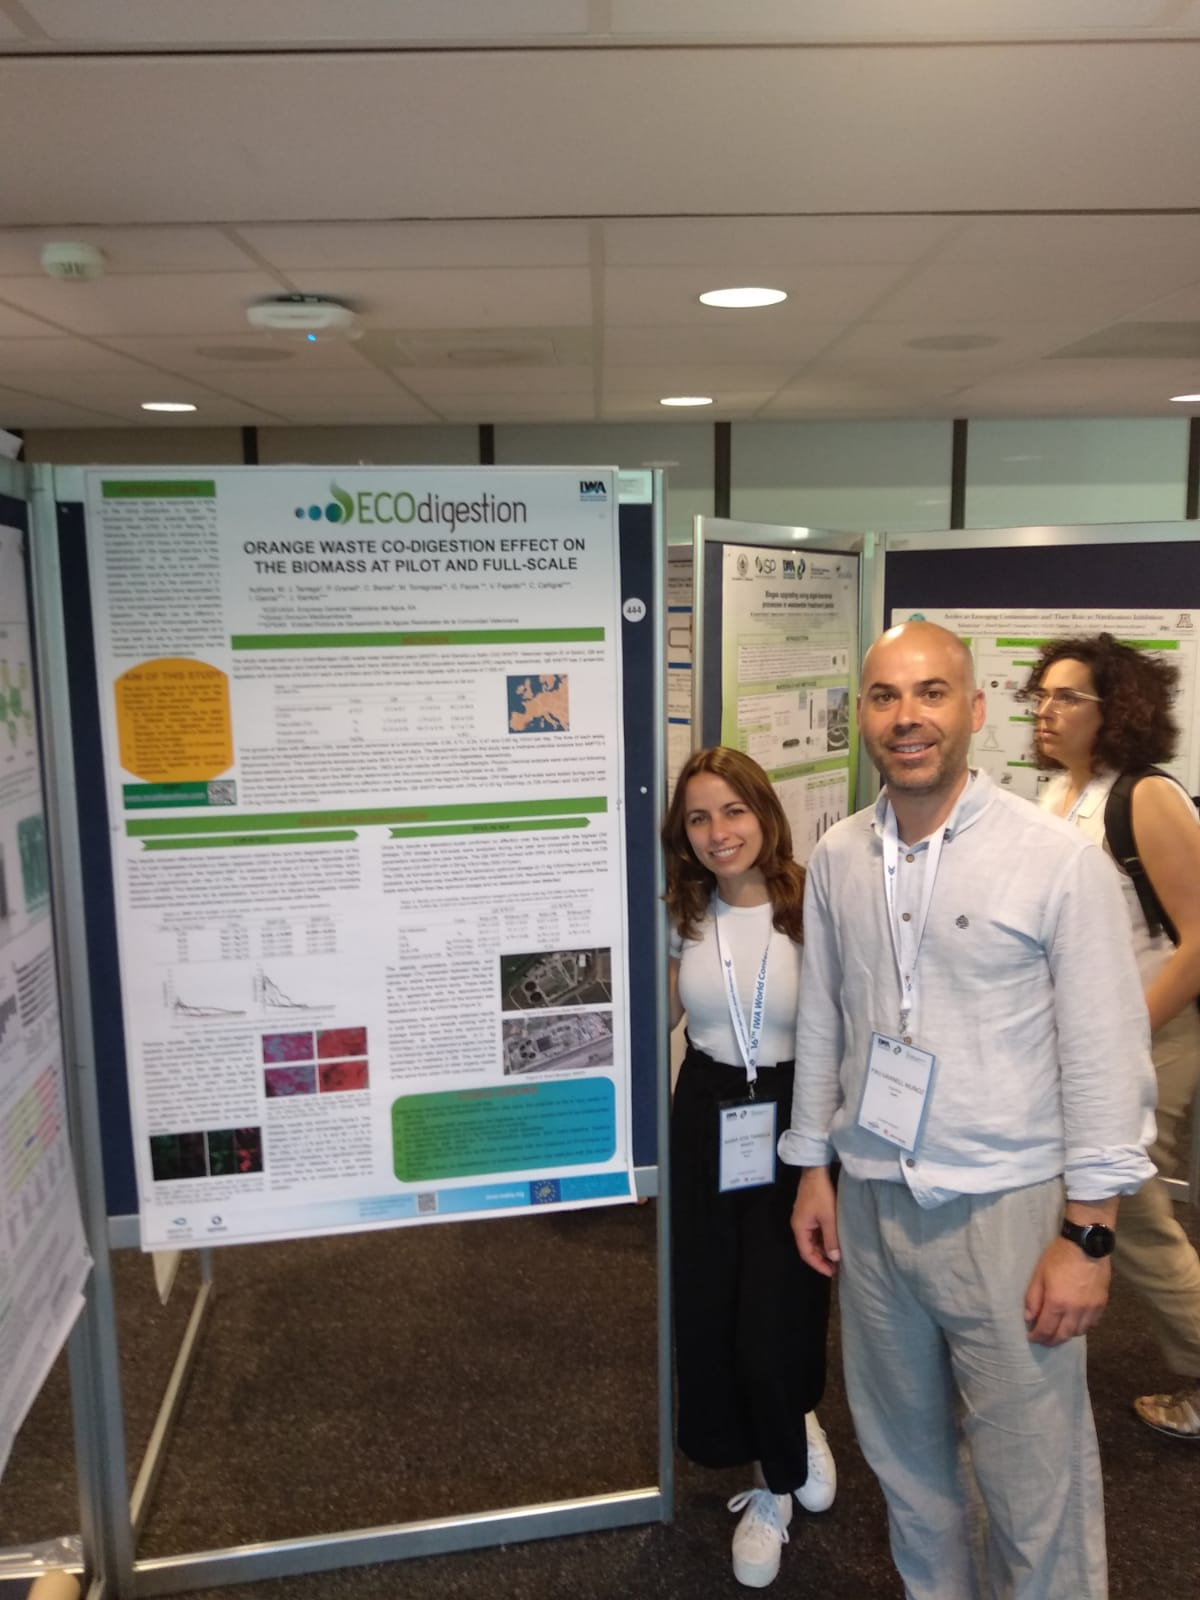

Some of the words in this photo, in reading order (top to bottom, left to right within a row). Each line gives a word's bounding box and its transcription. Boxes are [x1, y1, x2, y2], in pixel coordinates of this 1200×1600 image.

[356, 491, 528, 534] ECOdigestion
[243, 540, 316, 555] ORANGE
[319, 540, 377, 554] WASTE
[381, 539, 496, 554] CO-DIGESTION
[500, 538, 559, 552] EFFECT
[563, 538, 586, 551] ON
[254, 560, 287, 574] THE
[292, 560, 367, 574] BIOMASS
[371, 559, 390, 573] AT
[395, 559, 441, 573] PILOT
[445, 558, 478, 572] AND
[483, 557, 578, 571] FULL-SCALE
[625, 604, 642, 615] 444
[754, 981, 765, 1009] World
[752, 1011, 762, 1030] IWA
